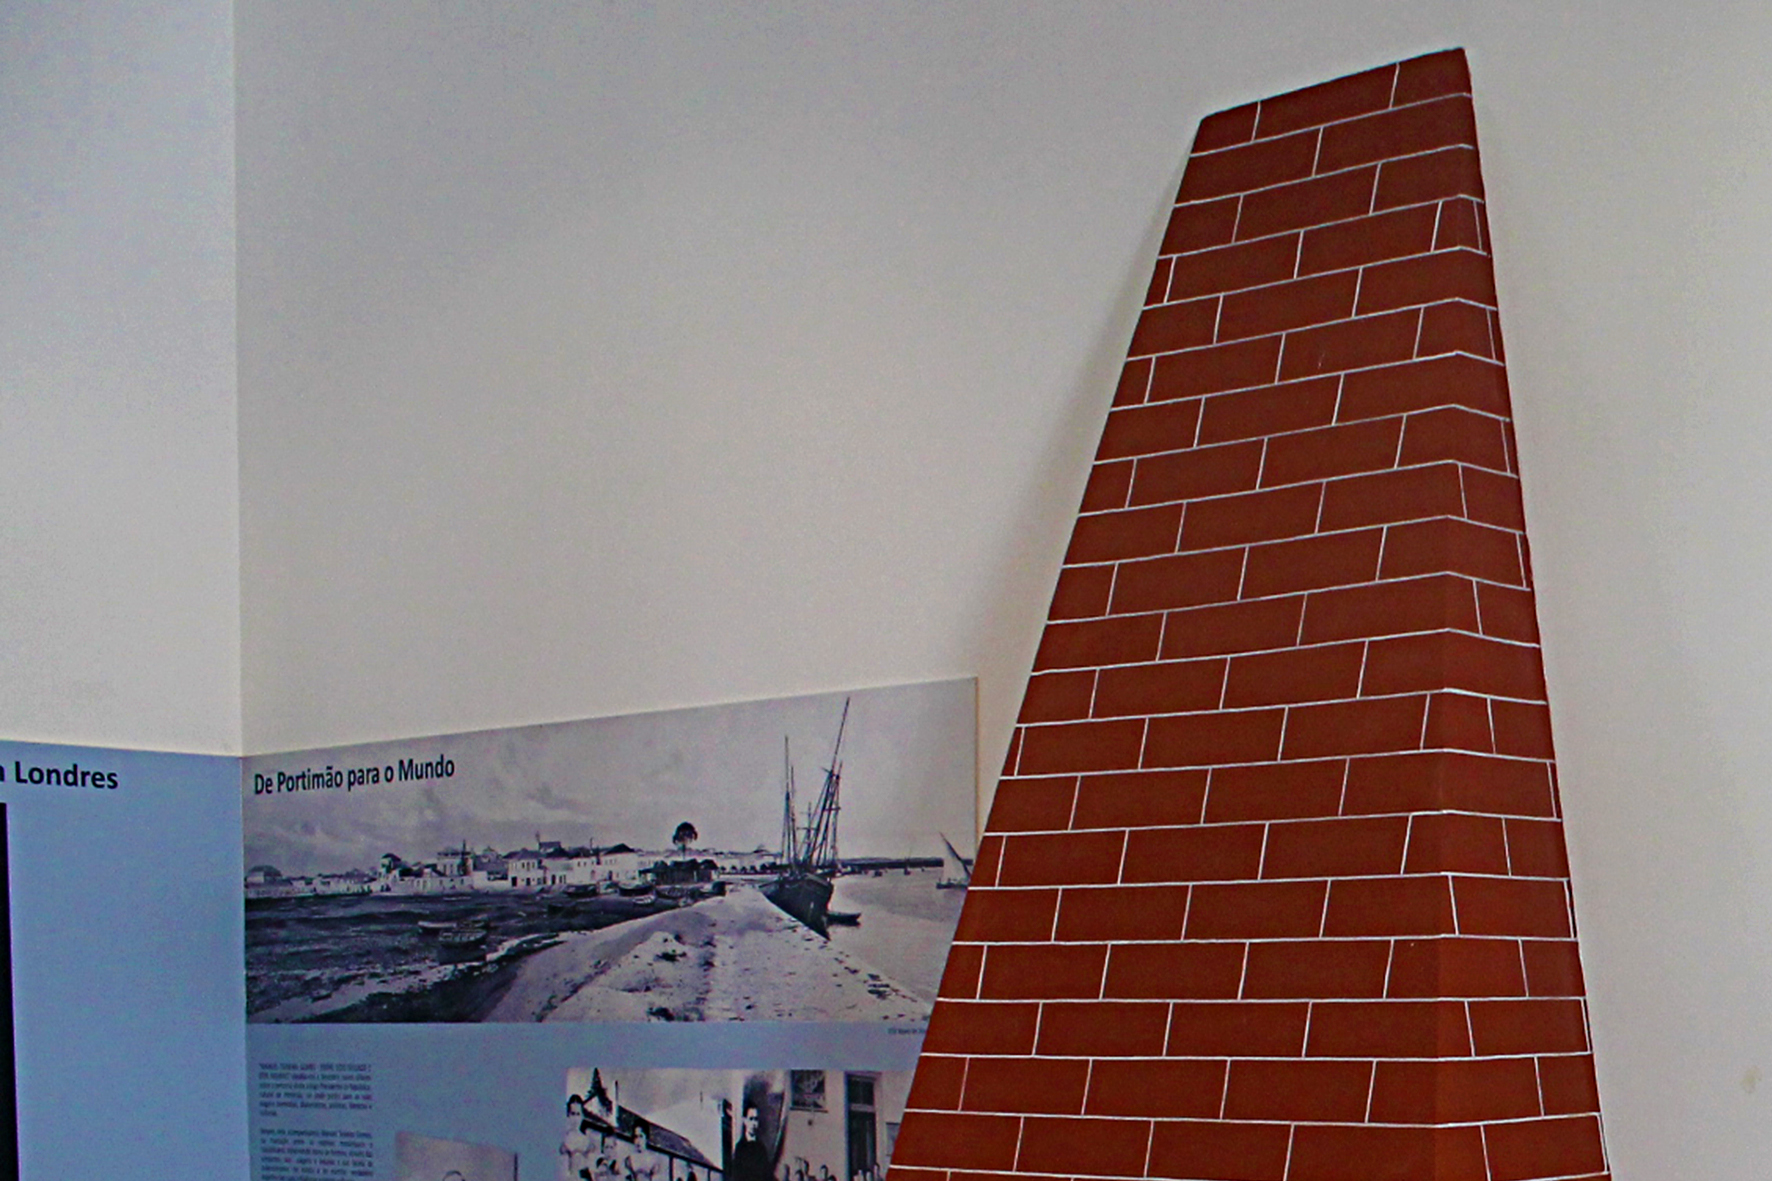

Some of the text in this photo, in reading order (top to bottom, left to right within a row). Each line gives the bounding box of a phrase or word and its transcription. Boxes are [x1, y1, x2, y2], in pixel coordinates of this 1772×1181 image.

[14, 760, 119, 790] Londres
[253, 754, 456, 796] De Portimão para o Mundo
